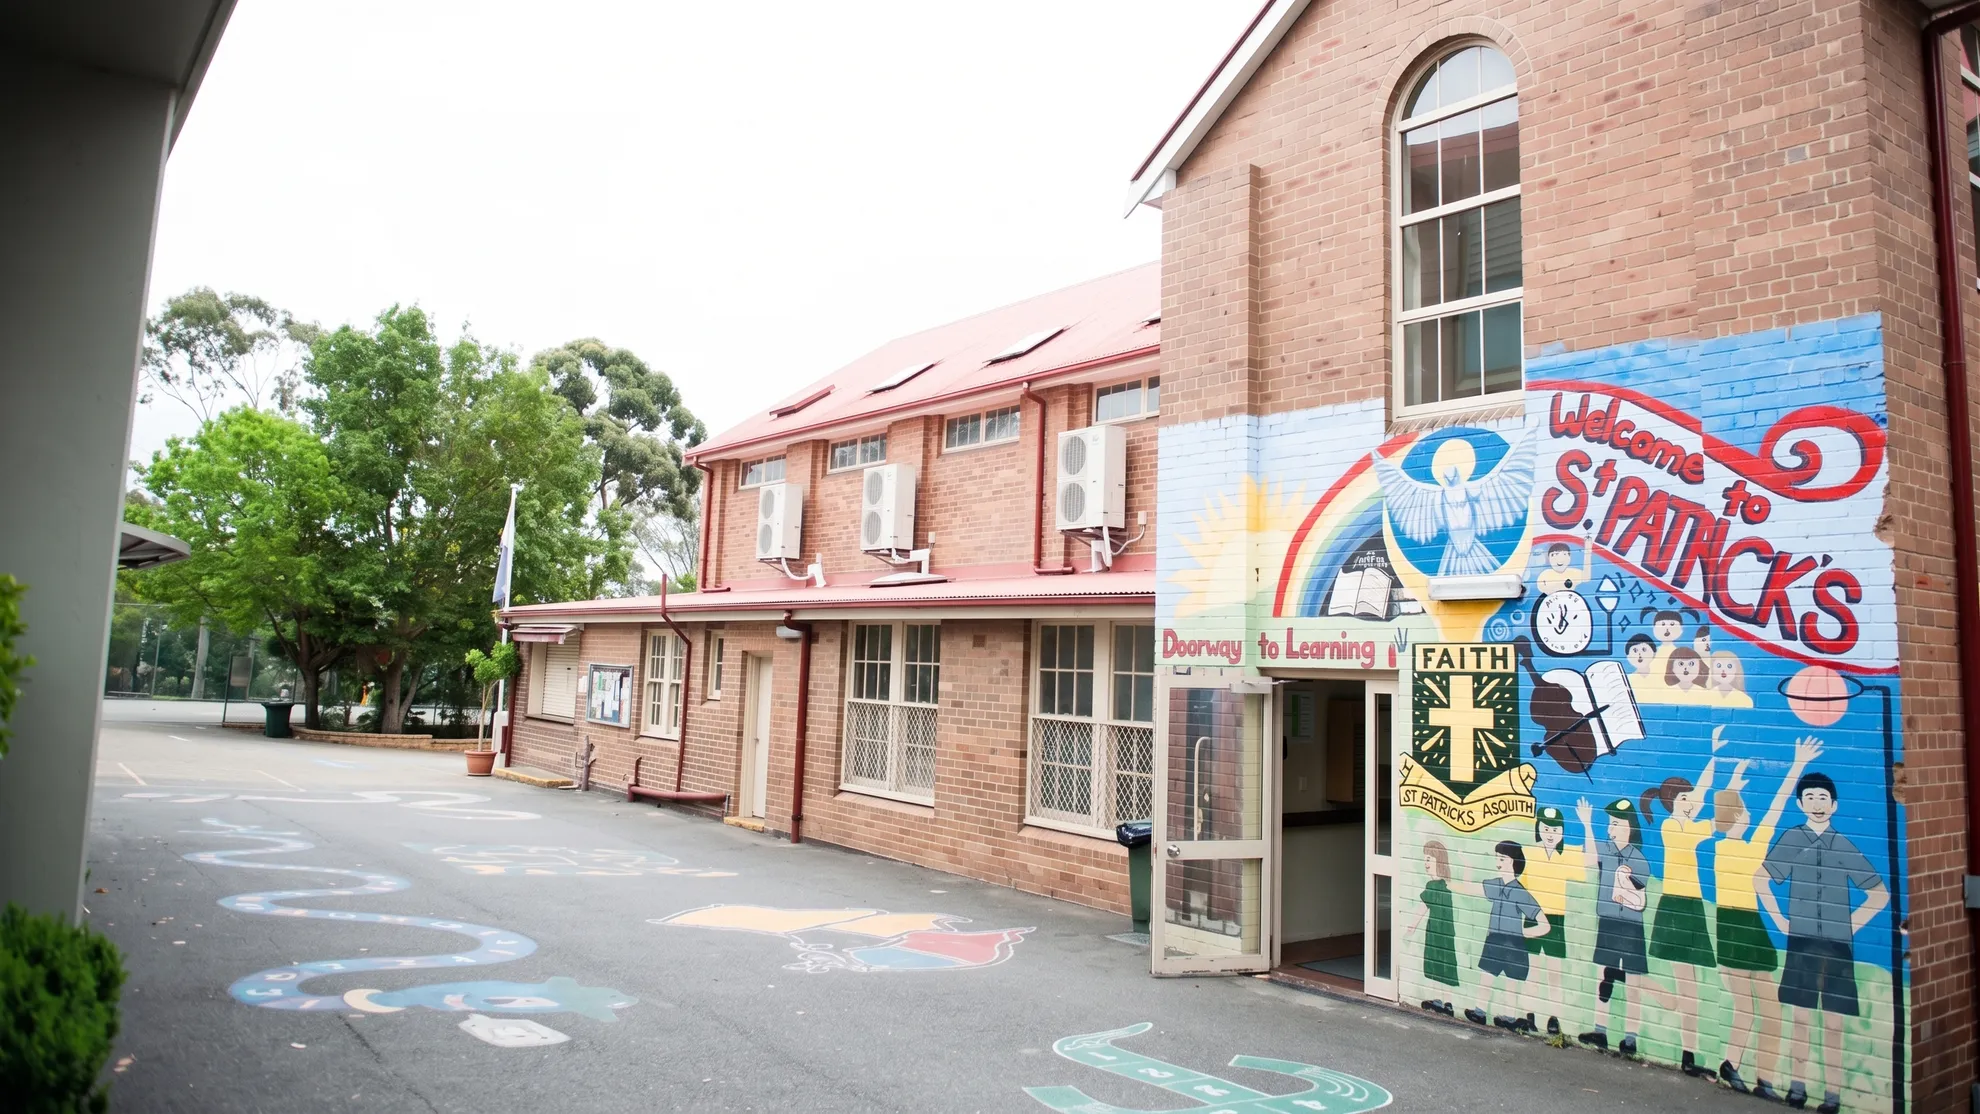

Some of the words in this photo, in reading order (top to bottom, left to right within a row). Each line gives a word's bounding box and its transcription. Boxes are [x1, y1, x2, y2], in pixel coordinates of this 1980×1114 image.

[1549, 392, 1705, 485] Welcome
[1722, 480, 1771, 525] to
[1594, 476, 1863, 655] PATRICK'S
[1162, 628, 1243, 665] Doorway
[1257, 631, 1280, 660] to
[1285, 627, 1376, 669] Learning
[1422, 646, 1509, 670] FAITH
[1403, 789, 1418, 803] ST
[1420, 791, 1476, 826] PATRICKS
[1482, 799, 1534, 819] ASQUITH
